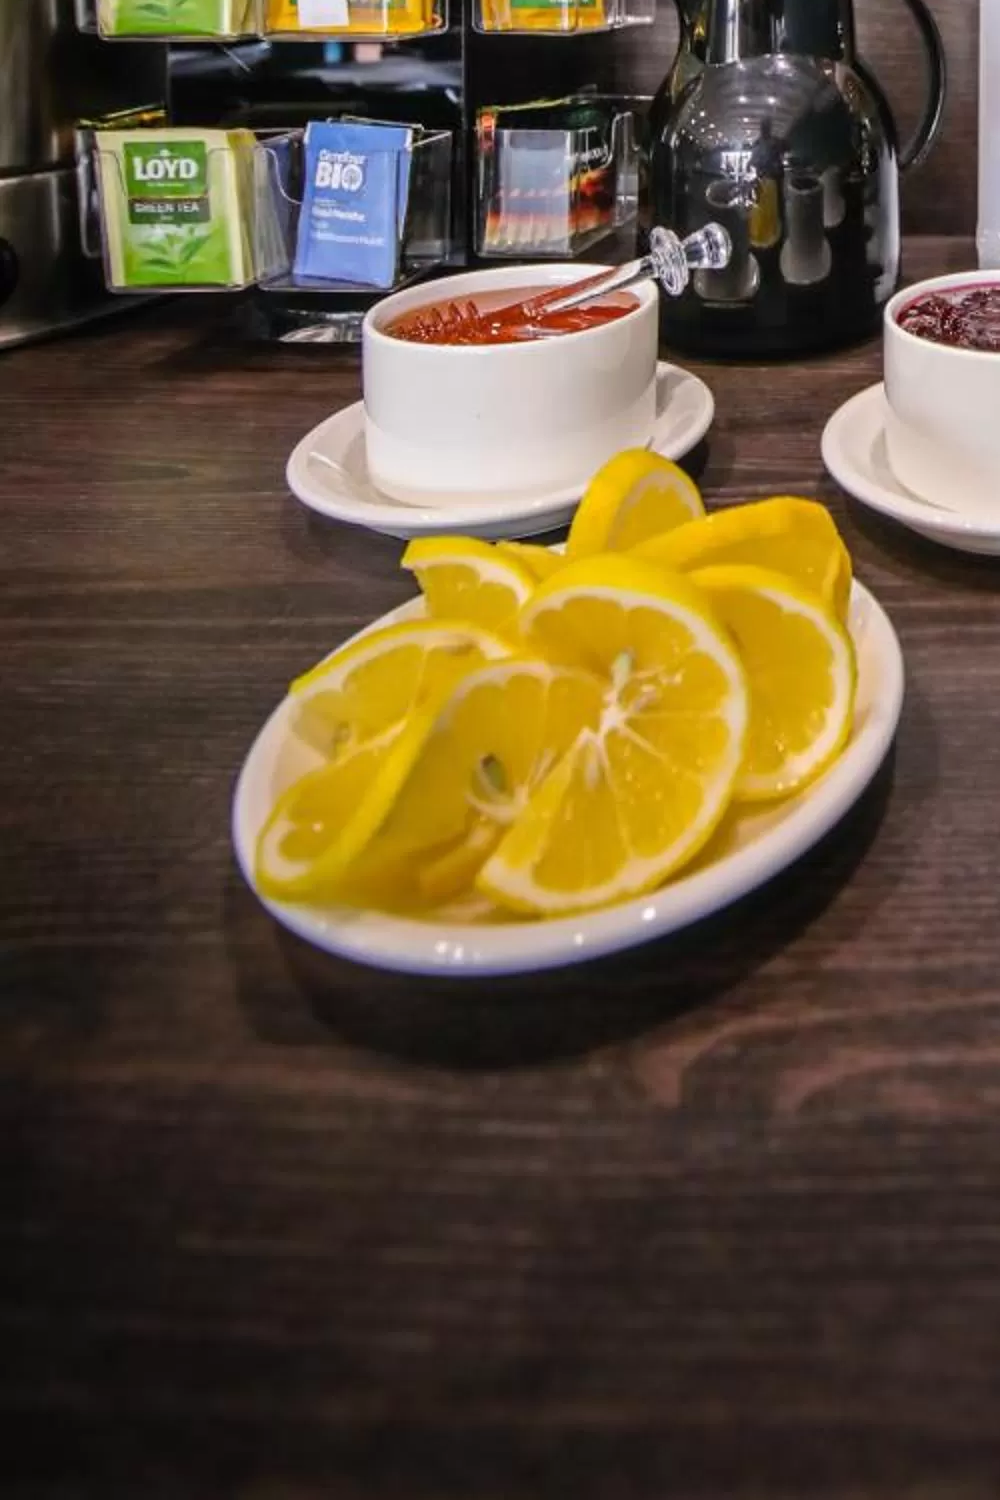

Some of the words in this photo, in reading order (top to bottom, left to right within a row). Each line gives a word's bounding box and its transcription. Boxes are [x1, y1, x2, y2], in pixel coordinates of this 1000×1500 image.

[132, 156, 200, 181] LOYD
[315, 161, 363, 192] BIO
[177, 201, 200, 213] TEA
